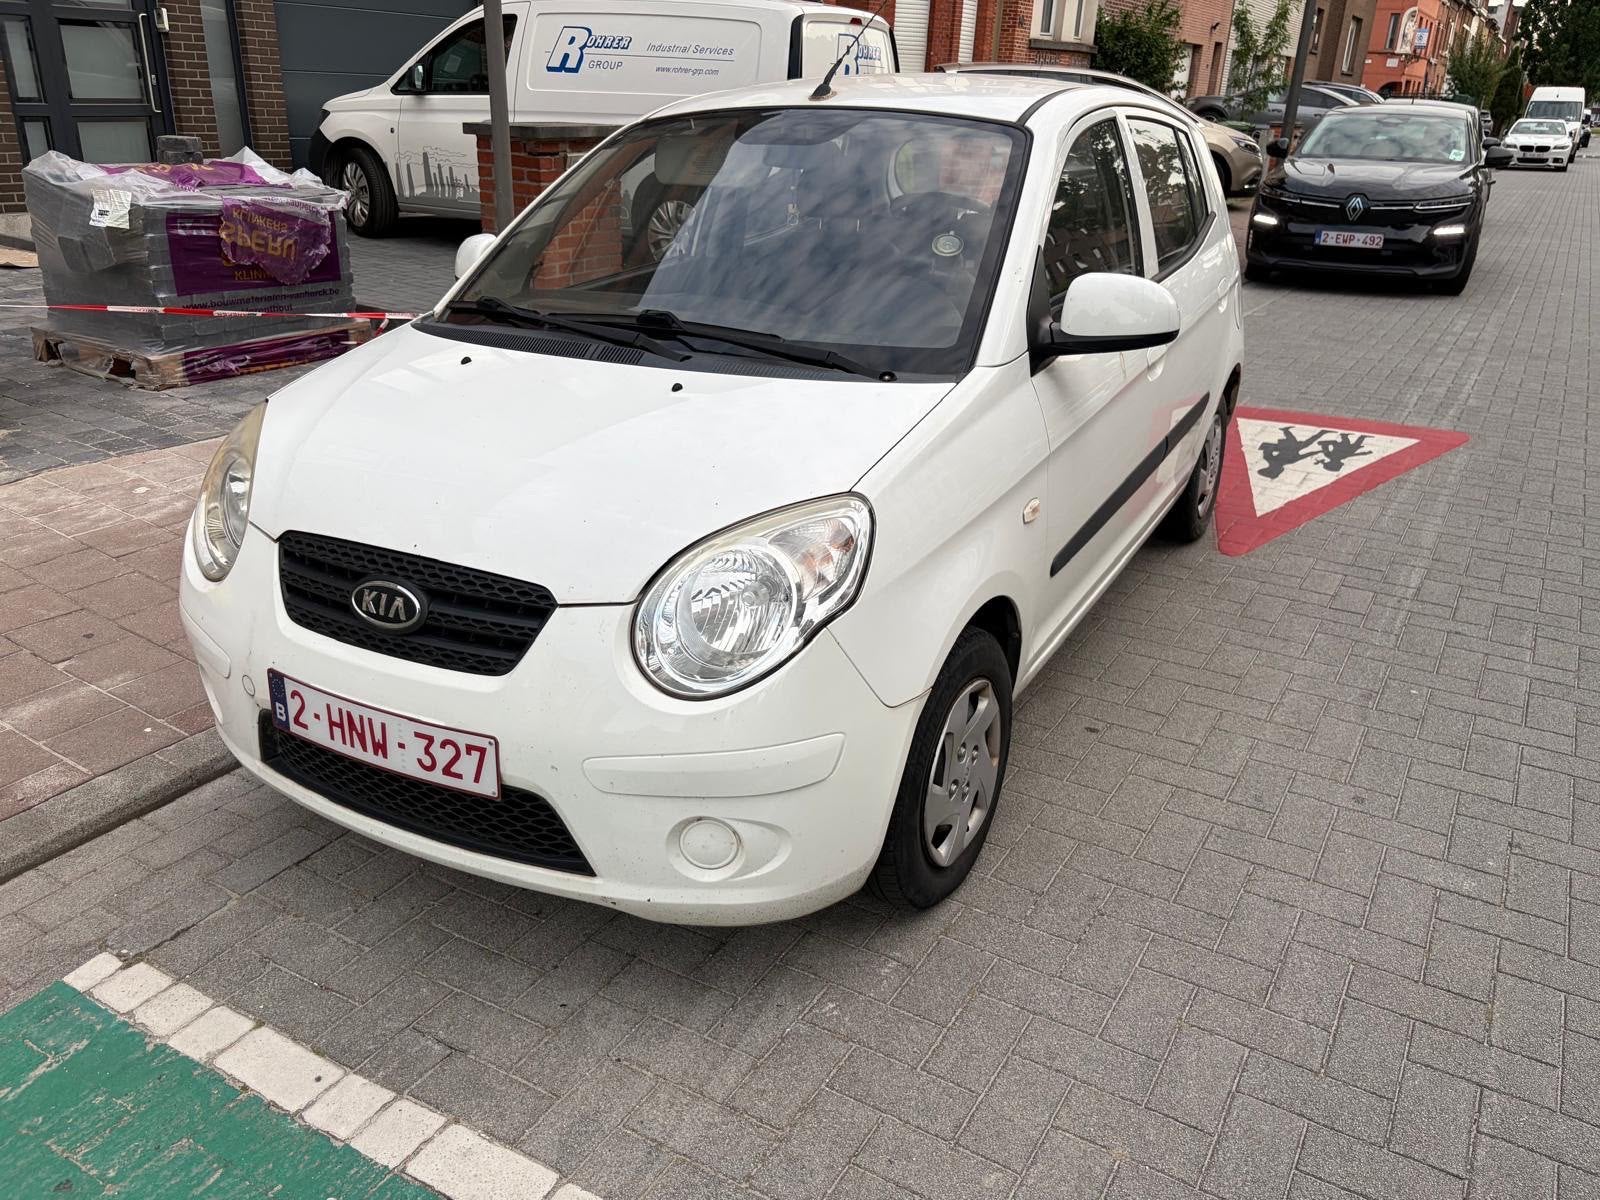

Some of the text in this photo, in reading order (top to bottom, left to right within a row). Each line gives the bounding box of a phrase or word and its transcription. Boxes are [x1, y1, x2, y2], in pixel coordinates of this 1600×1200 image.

[546, 26, 632, 73] ROHRER
[646, 42, 735, 56] Industrial Services
[588, 60, 623, 70] GROUP
[655, 66, 719, 77] www.rohrer-grp.com
[1322, 232, 1383, 247] 2-EWP-492
[361, 588, 407, 621] KIA
[275, 702, 286, 722] B
[290, 689, 488, 784] 2-HNW-327
